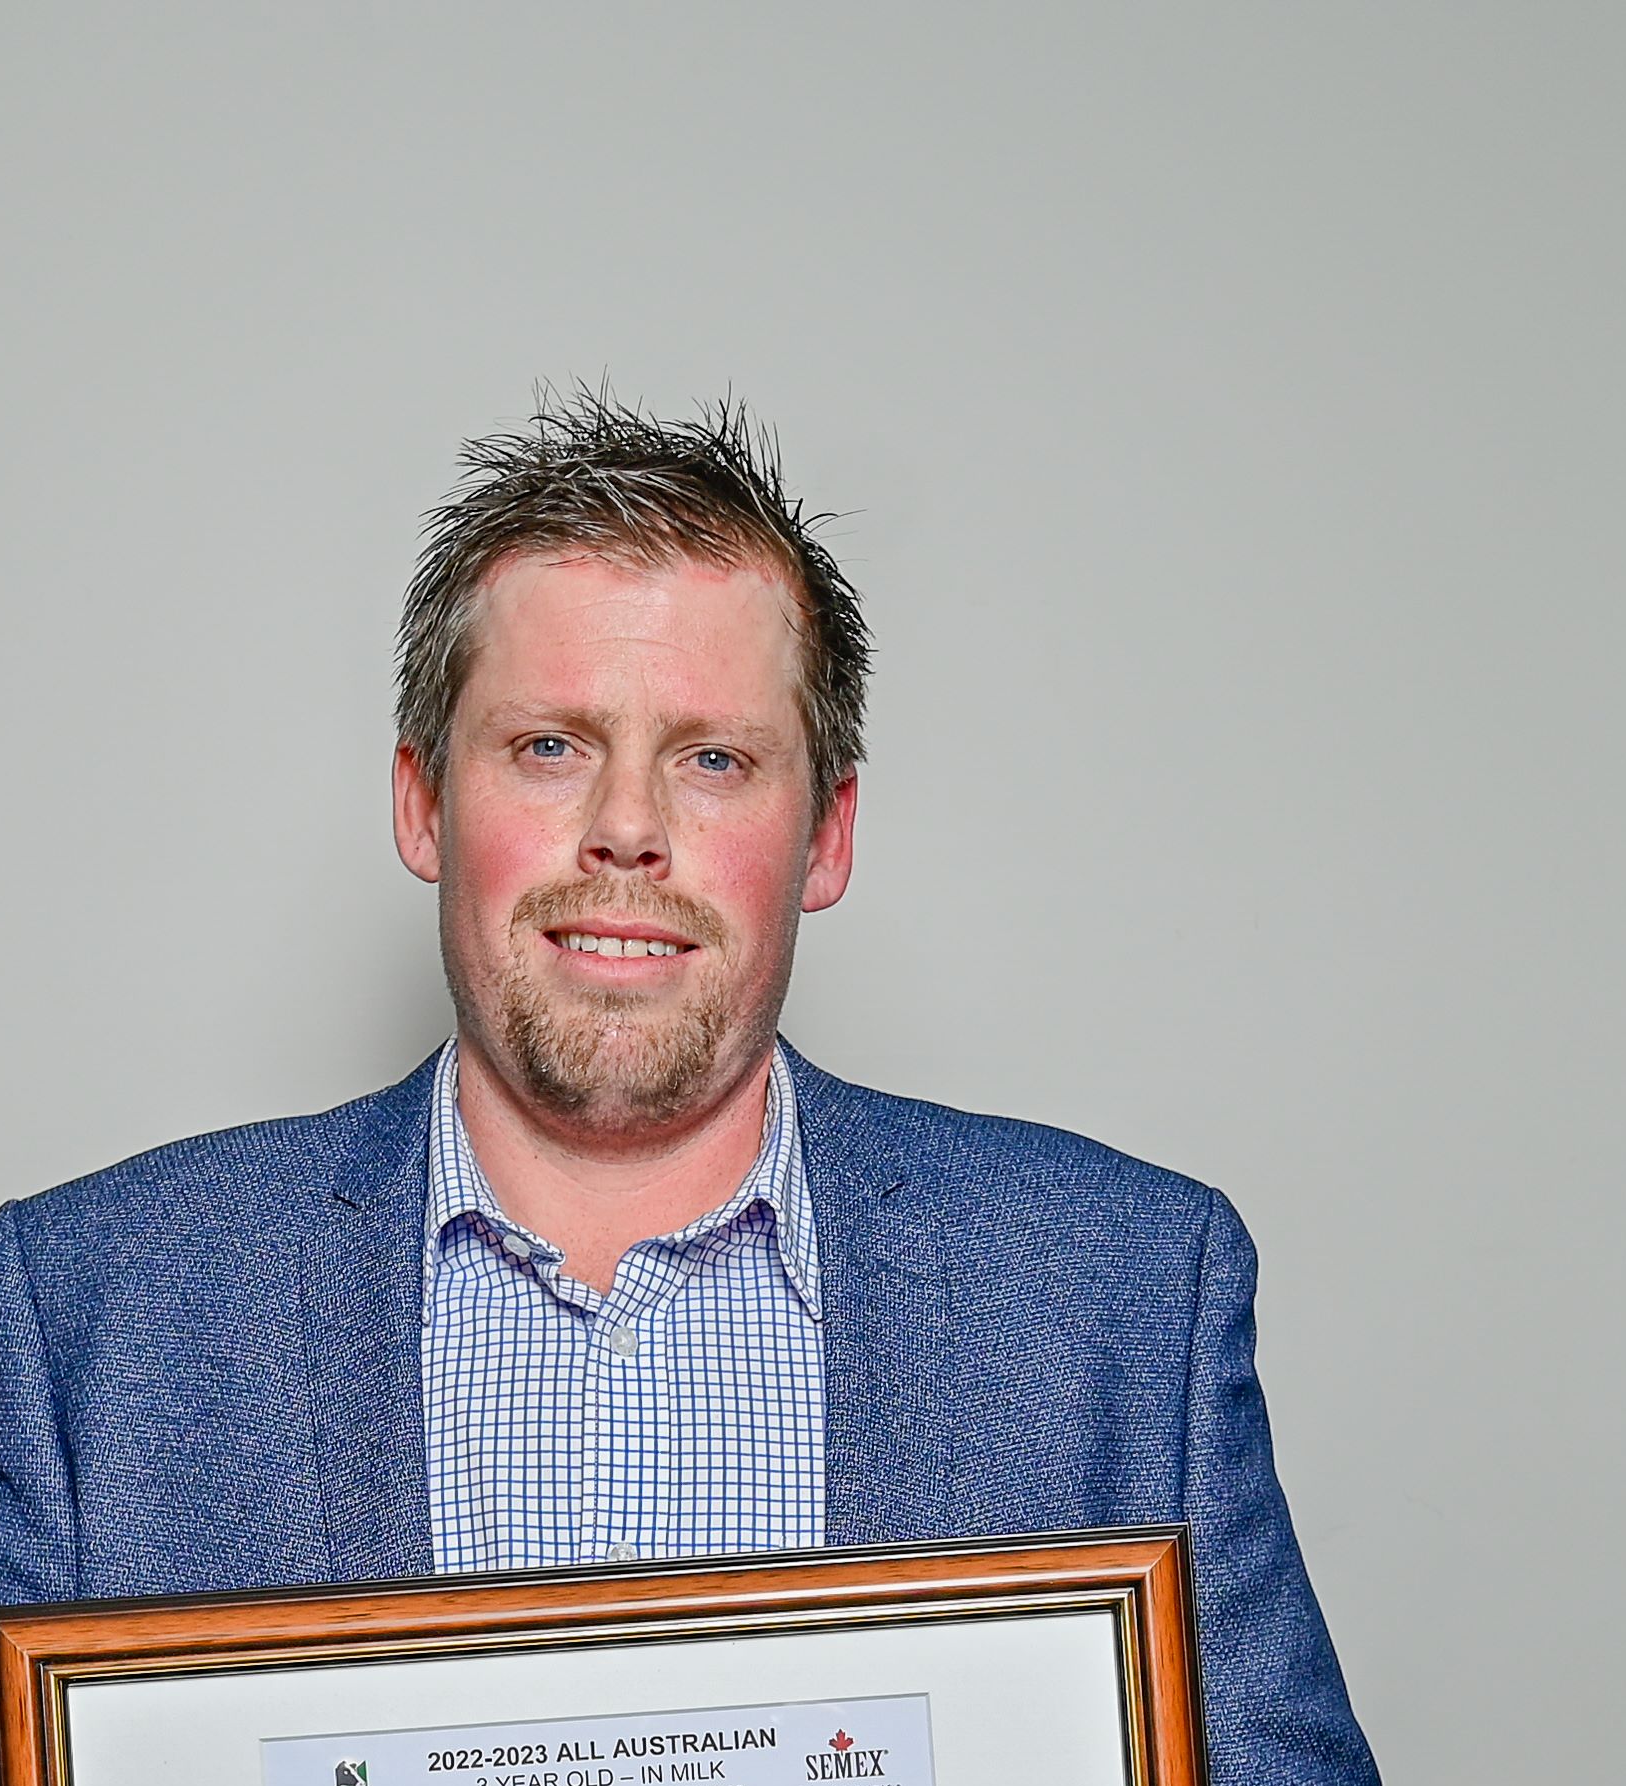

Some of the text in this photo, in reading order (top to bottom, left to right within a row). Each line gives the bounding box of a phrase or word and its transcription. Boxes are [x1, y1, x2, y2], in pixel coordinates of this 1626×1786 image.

[427, 1727, 776, 1772] 2022-2023 ALL AUSTRALIAN
[805, 1749, 886, 1781] SEMEX
[641, 1764, 663, 1785] IN
[671, 1760, 726, 1782] MILK
